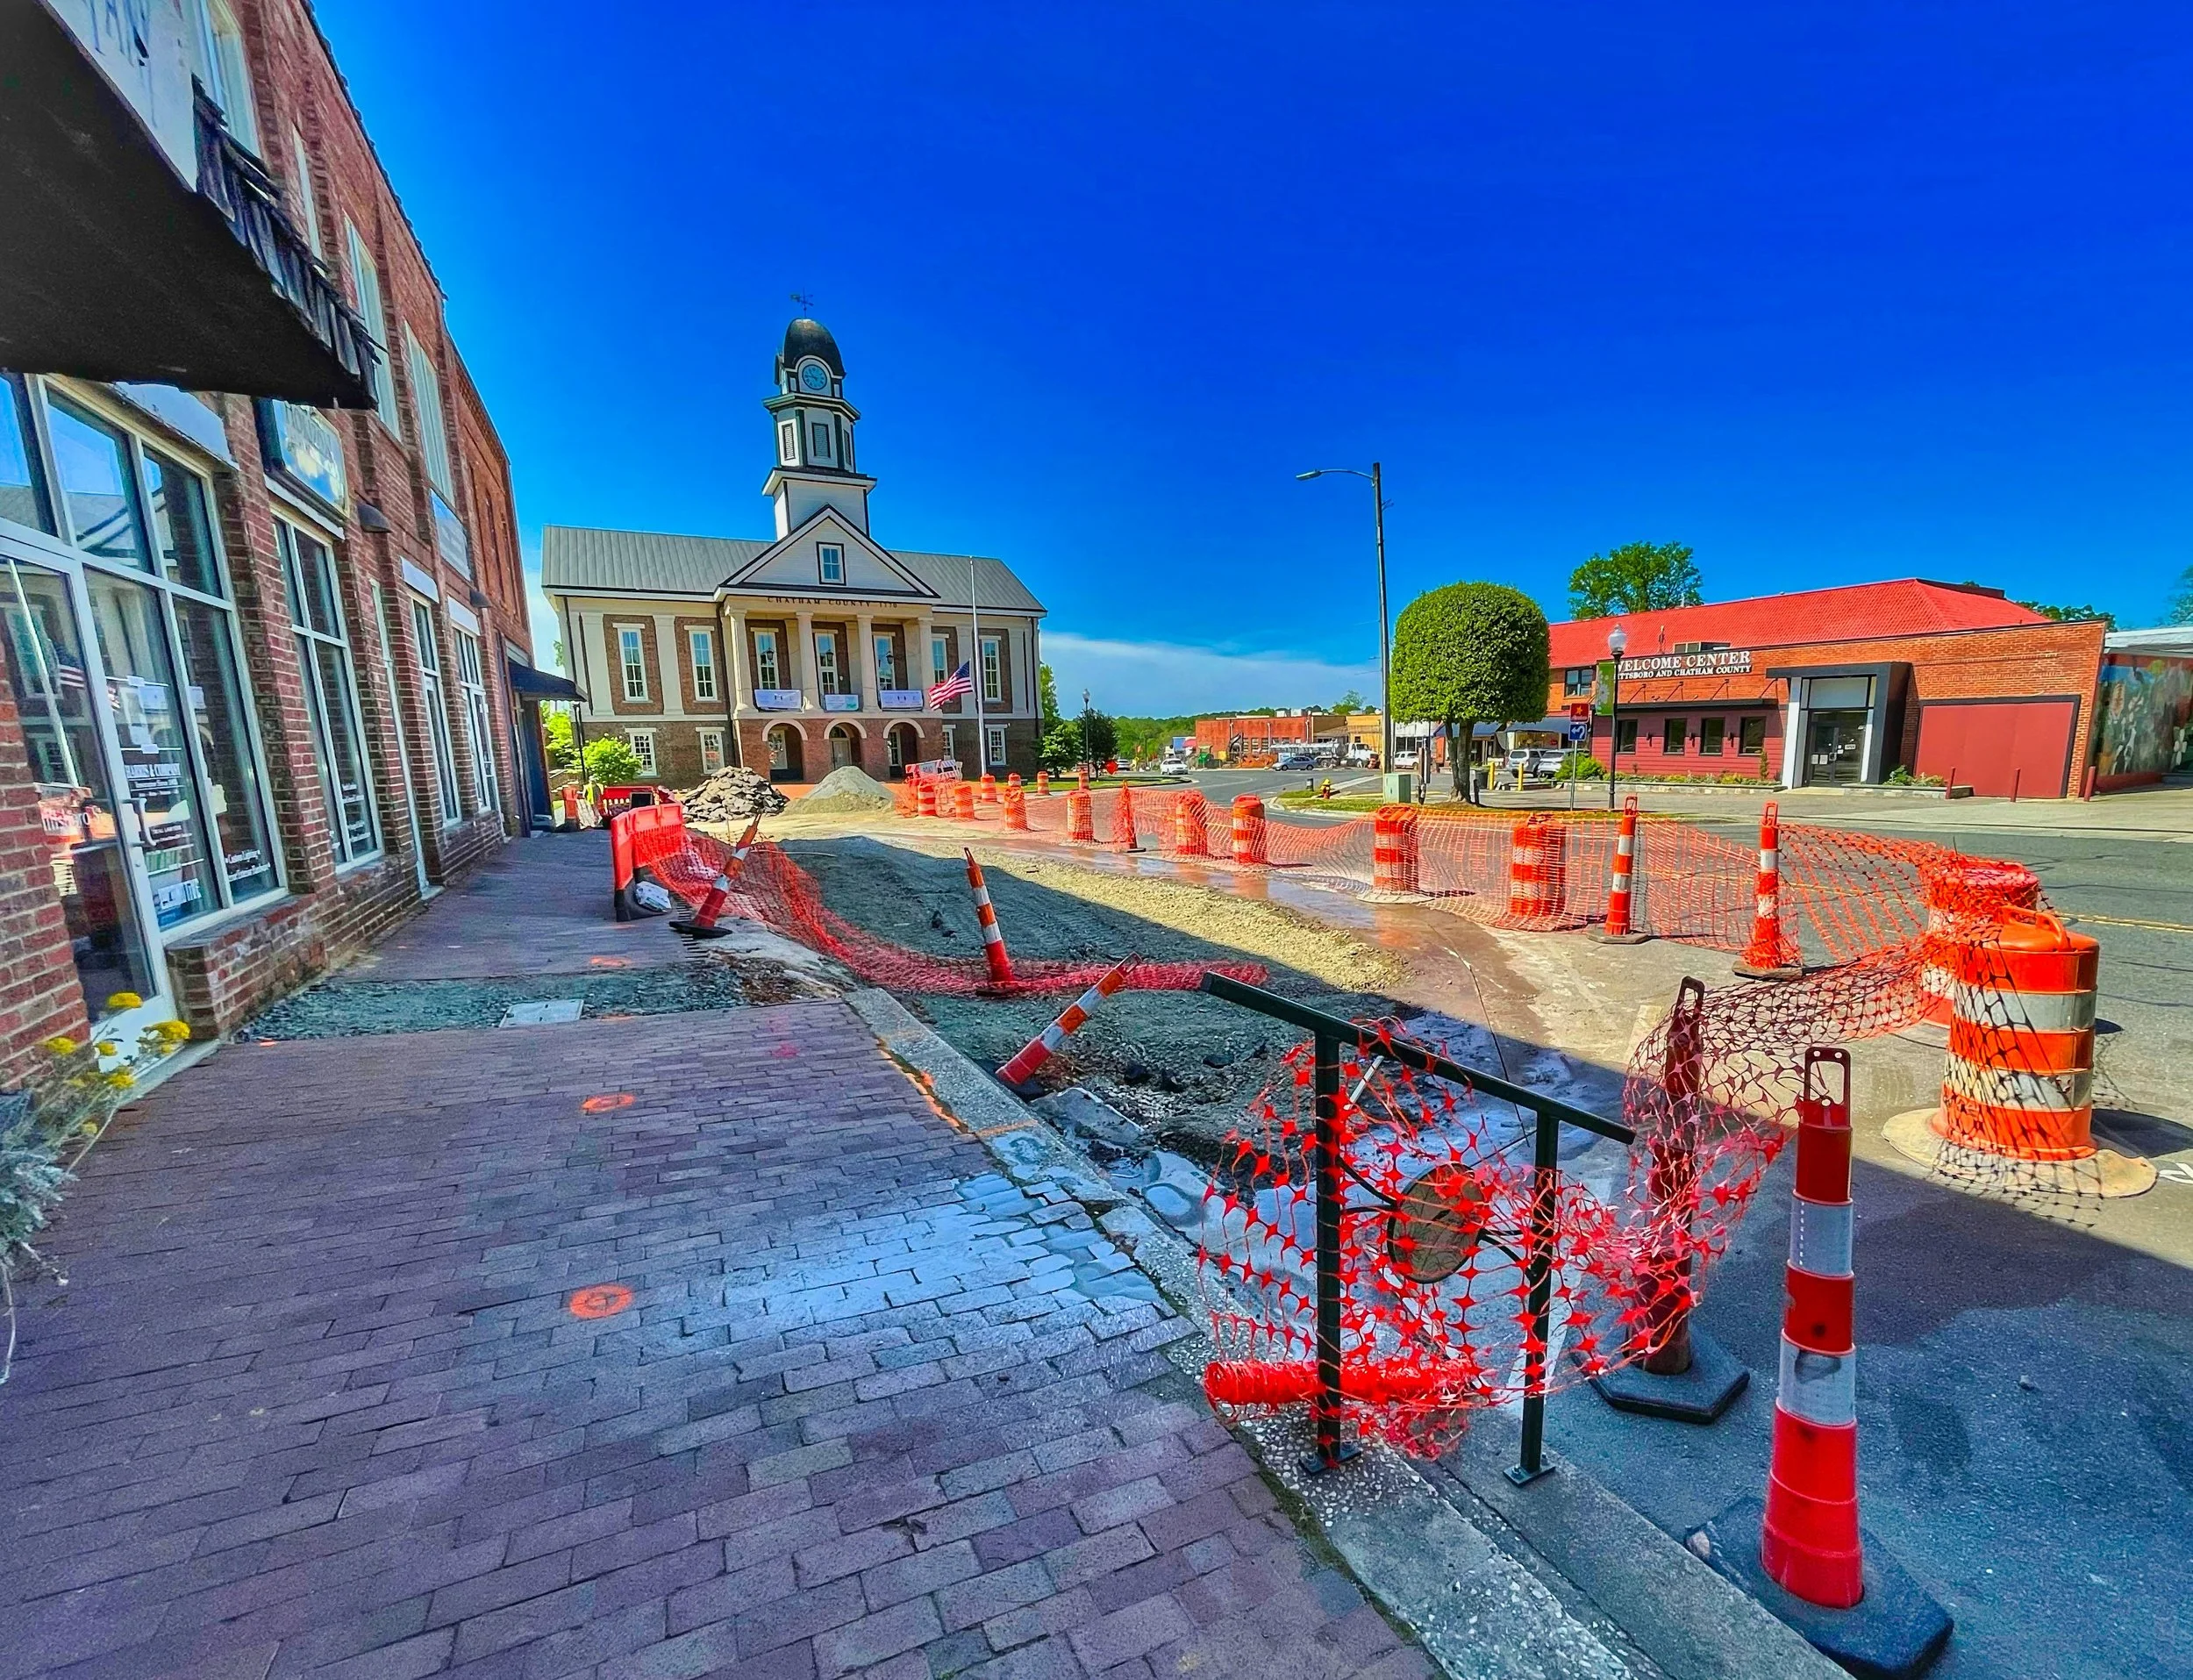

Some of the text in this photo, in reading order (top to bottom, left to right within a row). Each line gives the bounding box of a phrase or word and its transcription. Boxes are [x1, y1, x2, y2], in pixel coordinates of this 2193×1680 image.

[1686, 651, 1751, 668] CENTER
[1656, 669, 1673, 678] AND
[1674, 667, 1714, 676] CHATHAM
[1716, 665, 1751, 674] COUNTY
